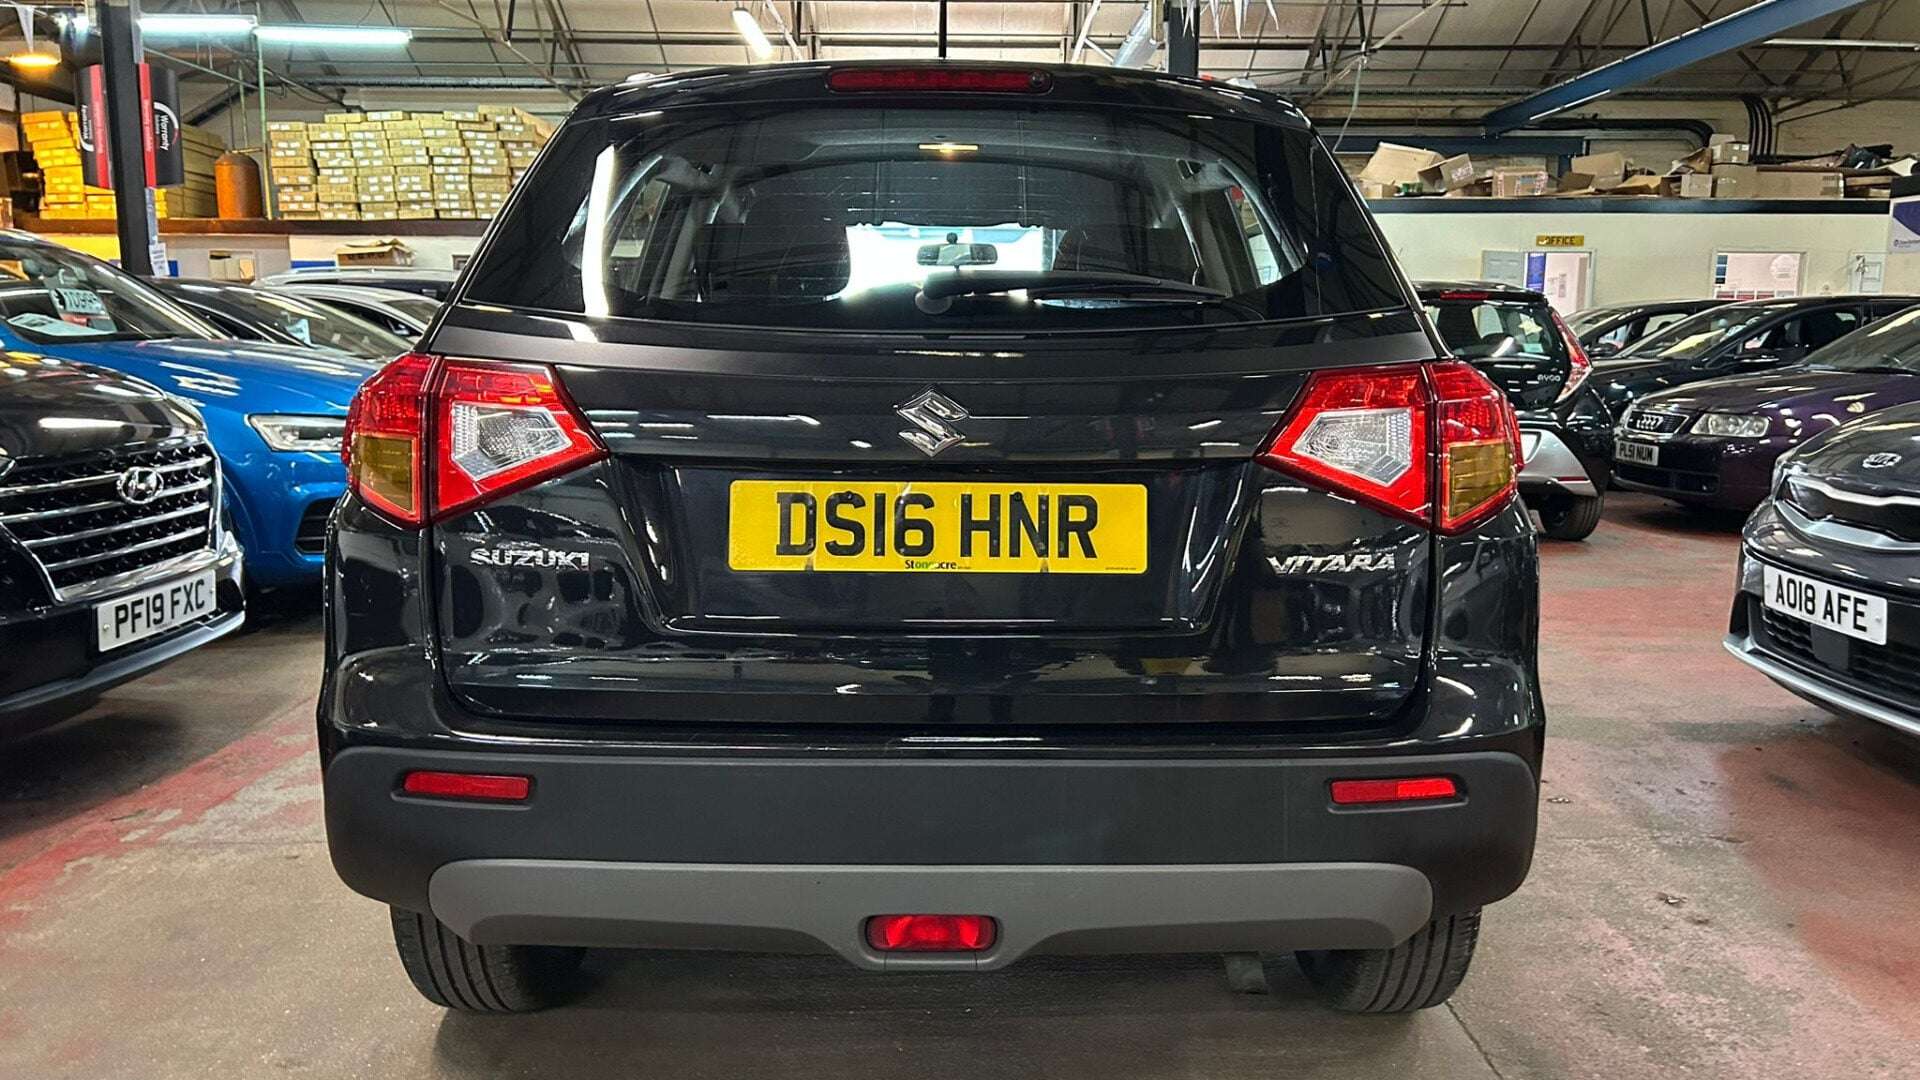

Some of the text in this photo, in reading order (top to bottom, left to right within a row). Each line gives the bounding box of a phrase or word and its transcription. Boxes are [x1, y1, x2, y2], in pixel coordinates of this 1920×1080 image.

[160, 114, 170, 151] Warranty
[1544, 236, 1576, 246] OFFICE
[775, 491, 1099, 559] DS16 HNR
[470, 548, 590, 571] SUZUKI
[1265, 553, 1395, 574] VITARA
[114, 578, 205, 639] PF19 FXC
[1775, 574, 1868, 633] AO18 AFE
